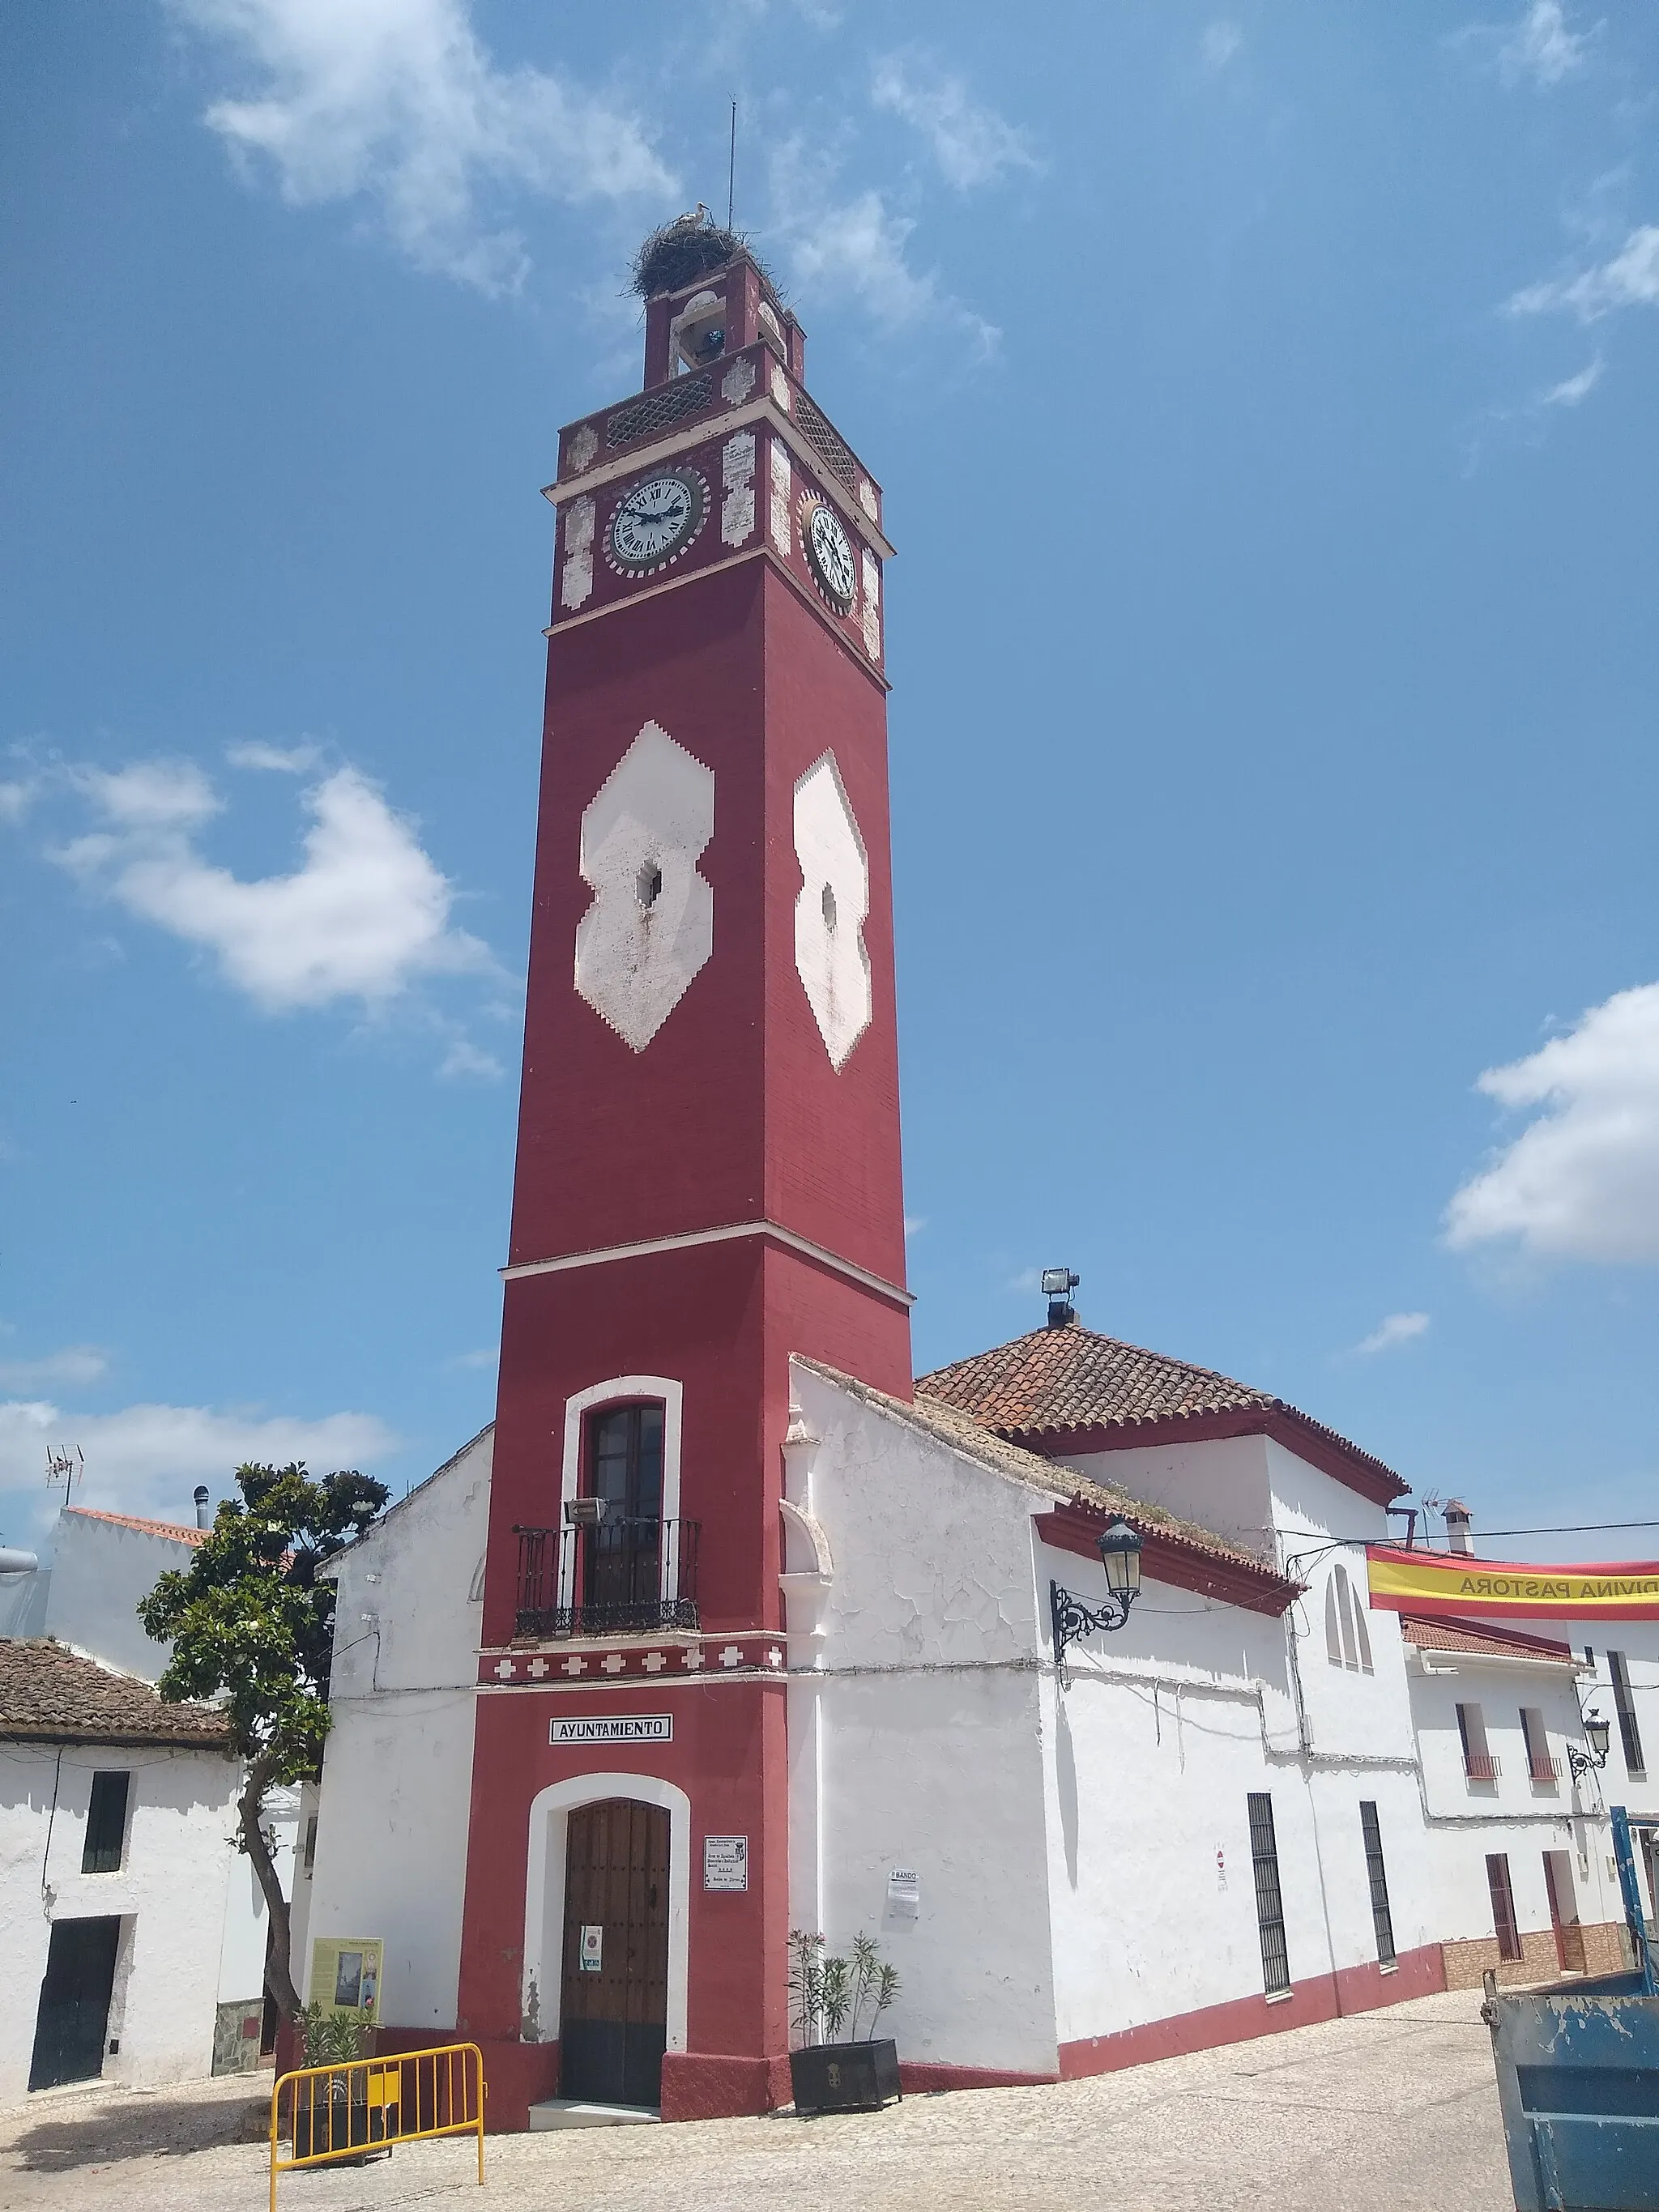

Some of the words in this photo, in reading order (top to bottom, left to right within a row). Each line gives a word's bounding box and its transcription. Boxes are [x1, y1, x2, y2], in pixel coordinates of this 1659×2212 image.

[649, 488, 661, 501] XII
[671, 494, 681, 505] II
[636, 496, 647, 509] XI
[559, 1720, 663, 1737] AYUNTAMIENTO
